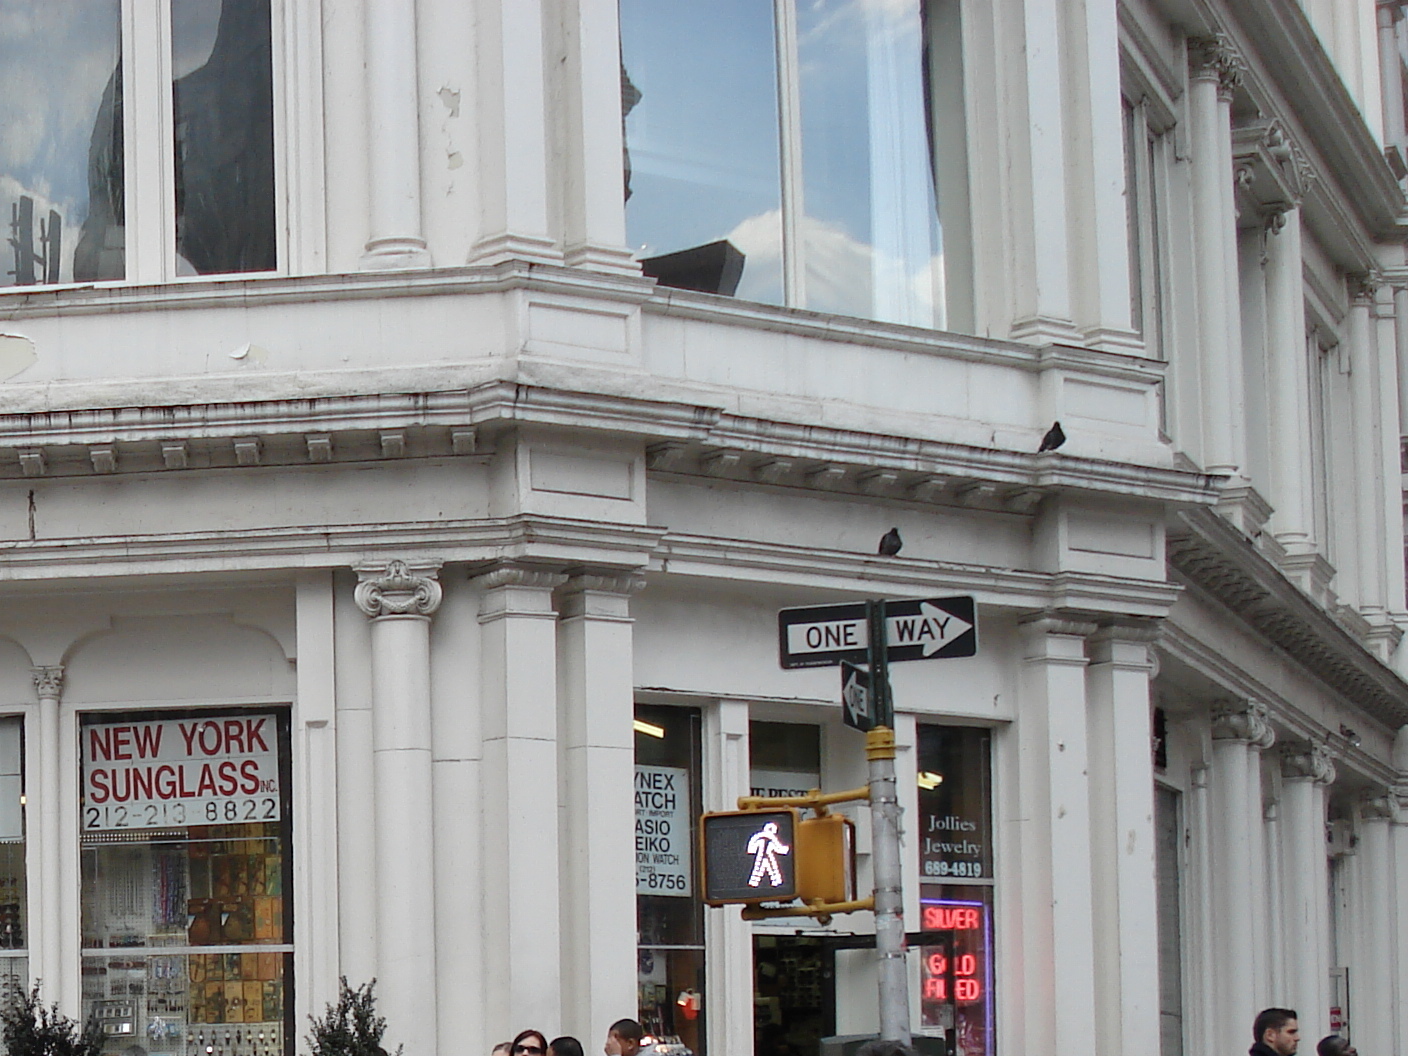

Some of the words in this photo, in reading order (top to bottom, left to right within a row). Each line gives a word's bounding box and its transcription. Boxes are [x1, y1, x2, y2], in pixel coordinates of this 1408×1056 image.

[805, 623, 858, 649] ONE
[896, 617, 951, 642] WAY
[90, 724, 163, 762] NEW
[178, 718, 269, 757] YORK
[90, 760, 260, 804] SUNGLASS
[928, 814, 976, 832] Jollies
[652, 853, 679, 865] WATCH
[924, 838, 982, 858] Jewelry
[925, 860, 982, 877] 689-4819
[924, 907, 979, 930] SILVER
[929, 954, 976, 976] GLD
